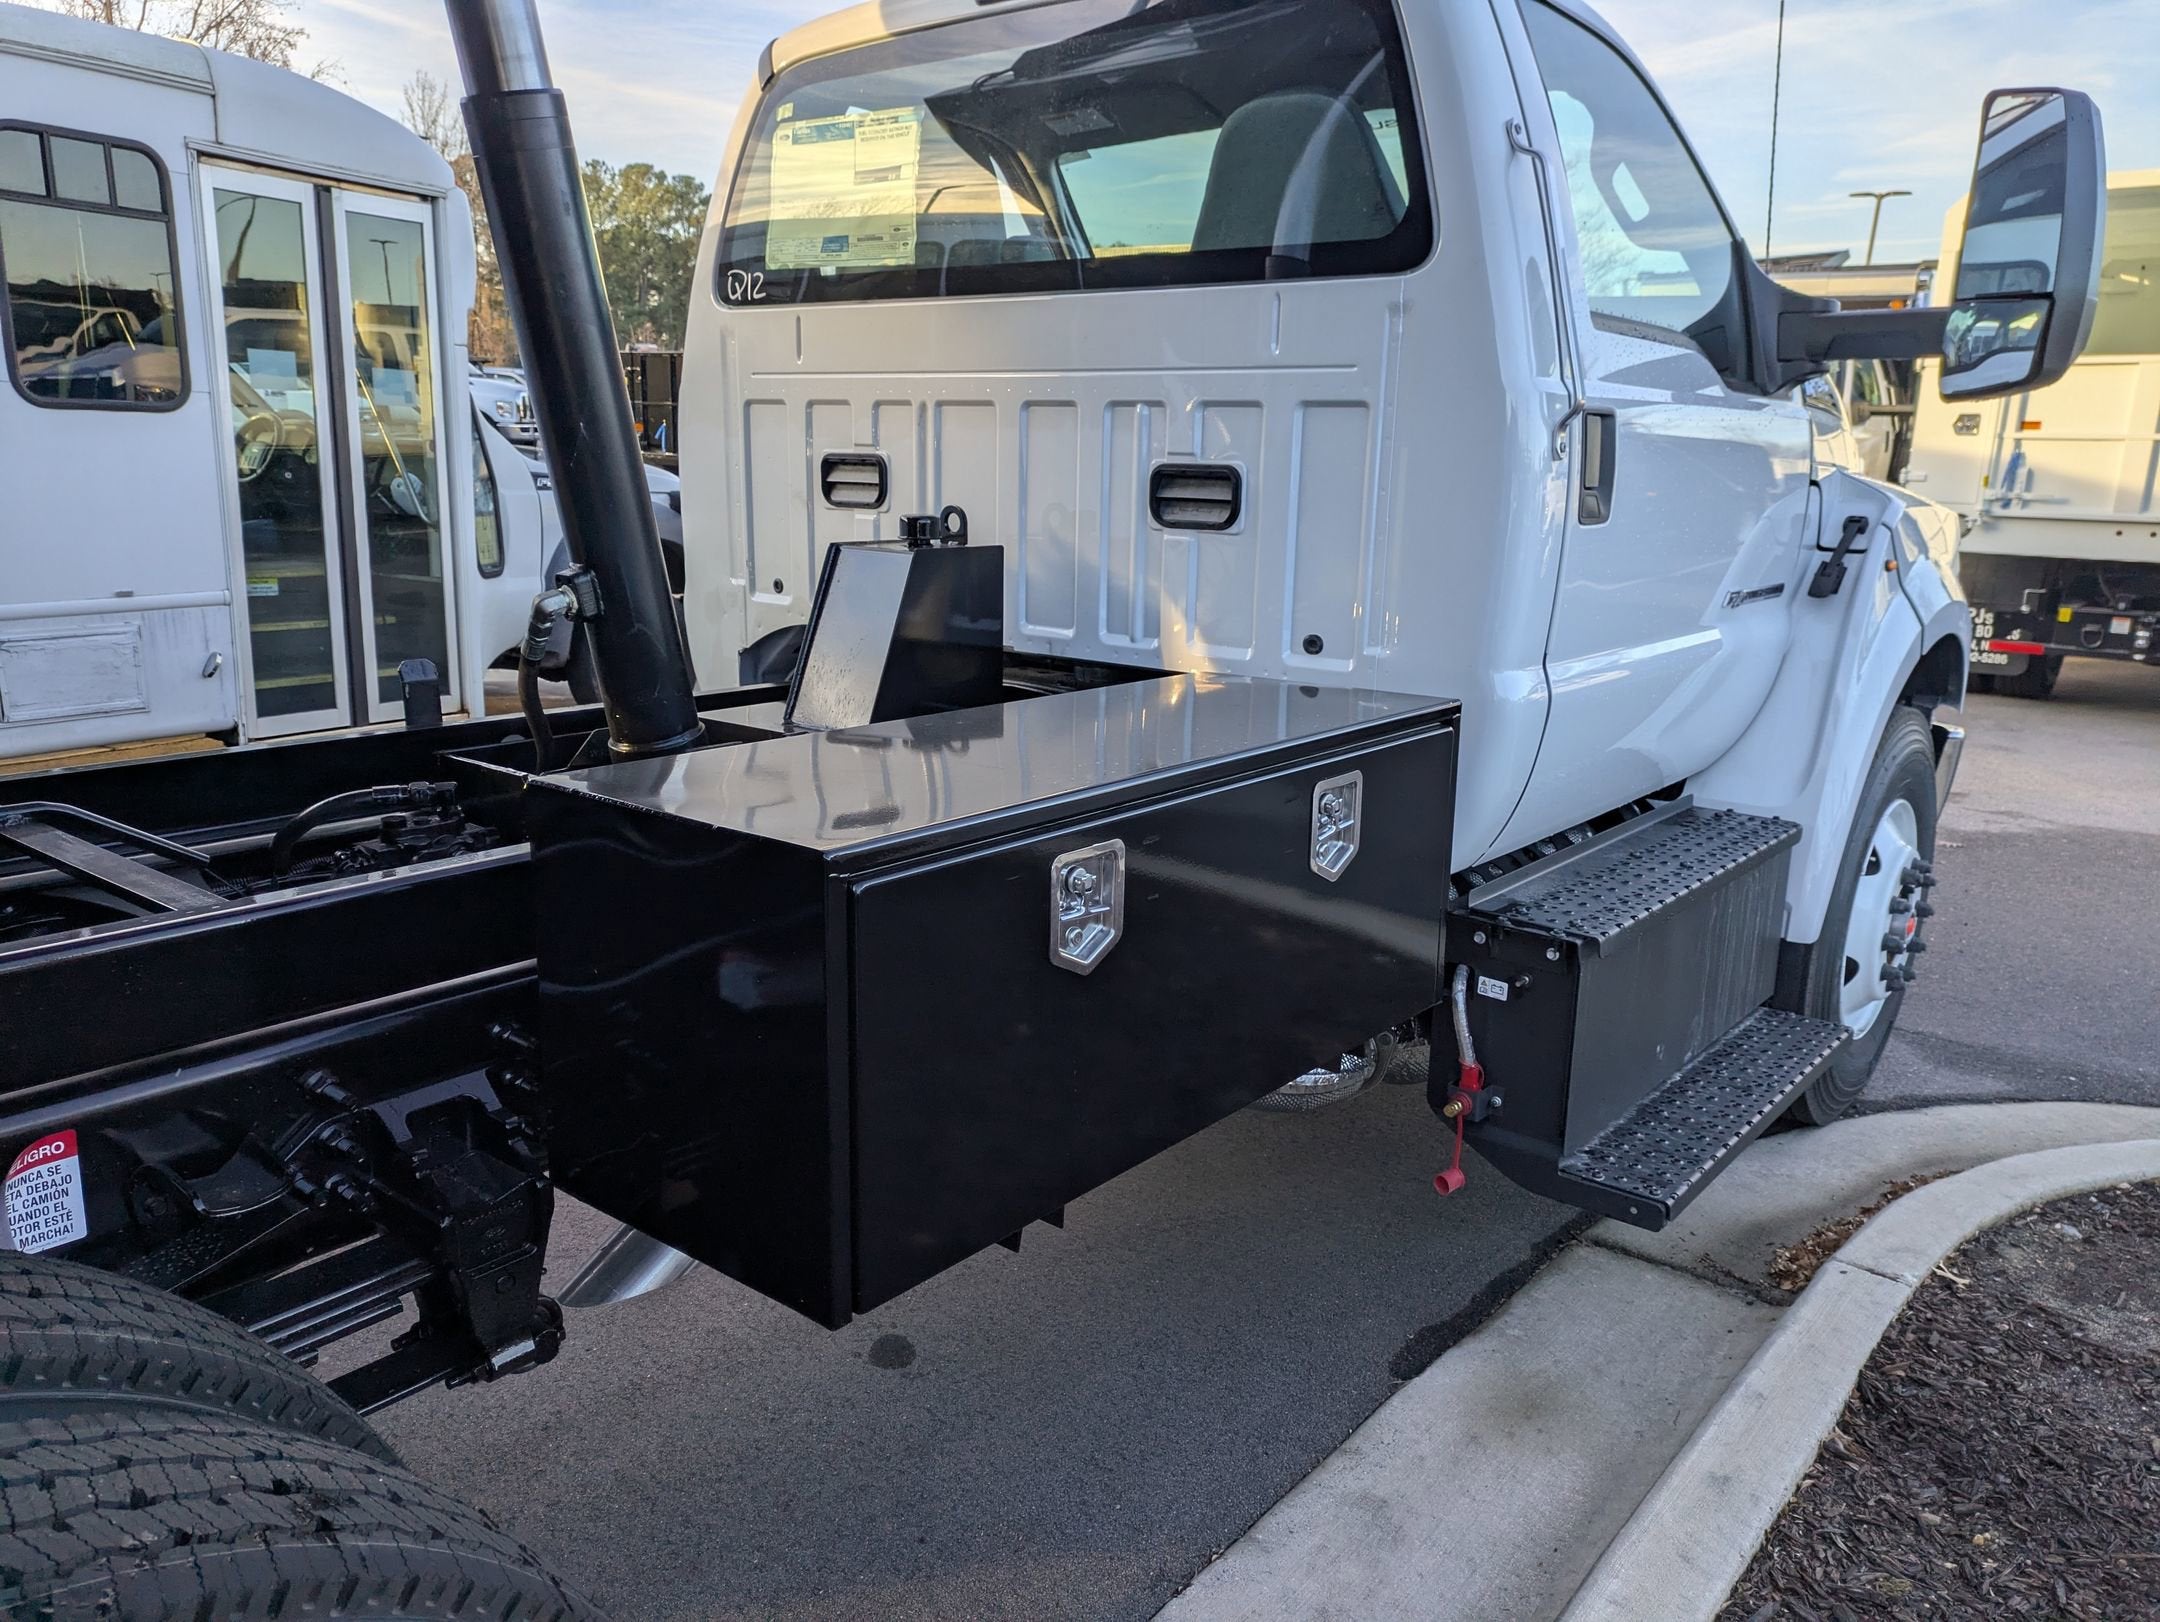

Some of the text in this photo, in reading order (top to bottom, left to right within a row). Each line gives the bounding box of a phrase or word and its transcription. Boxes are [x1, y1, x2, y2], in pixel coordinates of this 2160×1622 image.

[727, 269, 766, 300] Q12
[7, 1164, 62, 1192] NUNCA SE
[26, 1174, 72, 1196] DEBAJO
[22, 1187, 69, 1210] CAMIÓN
[54, 1201, 67, 1213] EL
[44, 1208, 73, 1228] ESTÉ
[19, 1223, 74, 1249] MARCHA!
